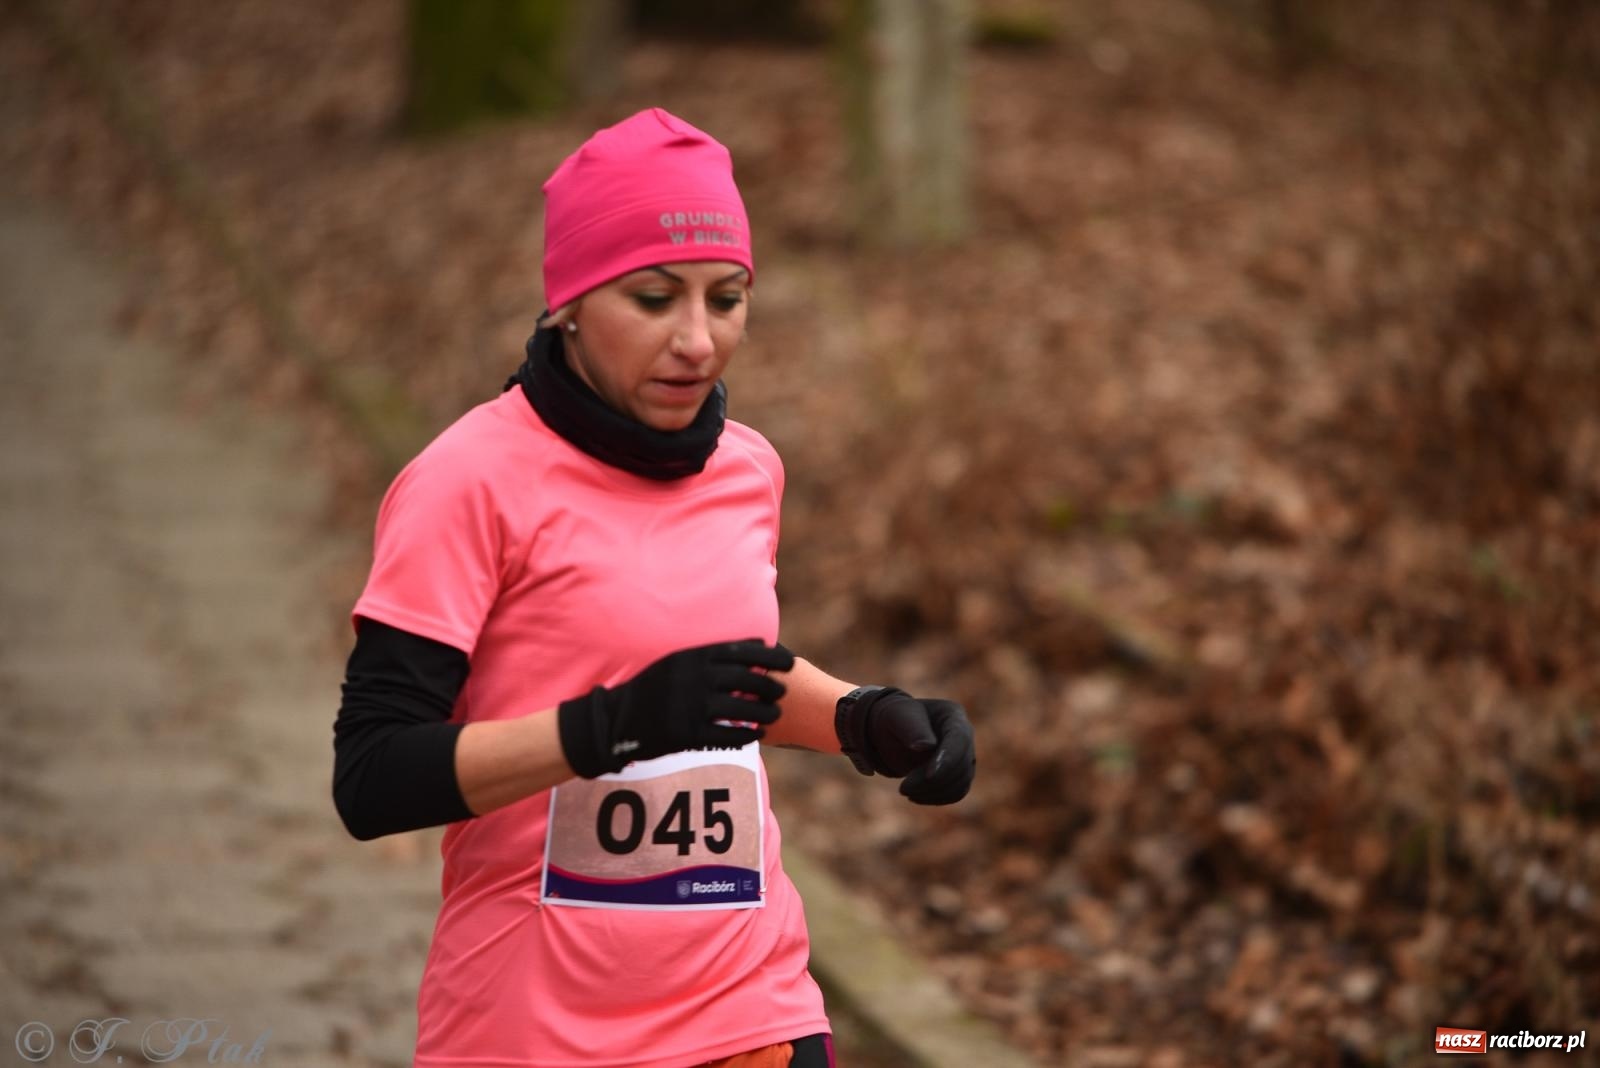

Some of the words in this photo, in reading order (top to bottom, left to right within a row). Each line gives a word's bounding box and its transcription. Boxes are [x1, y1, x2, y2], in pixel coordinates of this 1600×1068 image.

[668, 231, 687, 246] W
[596, 788, 733, 856] 045
[692, 880, 736, 894] Racibórz
